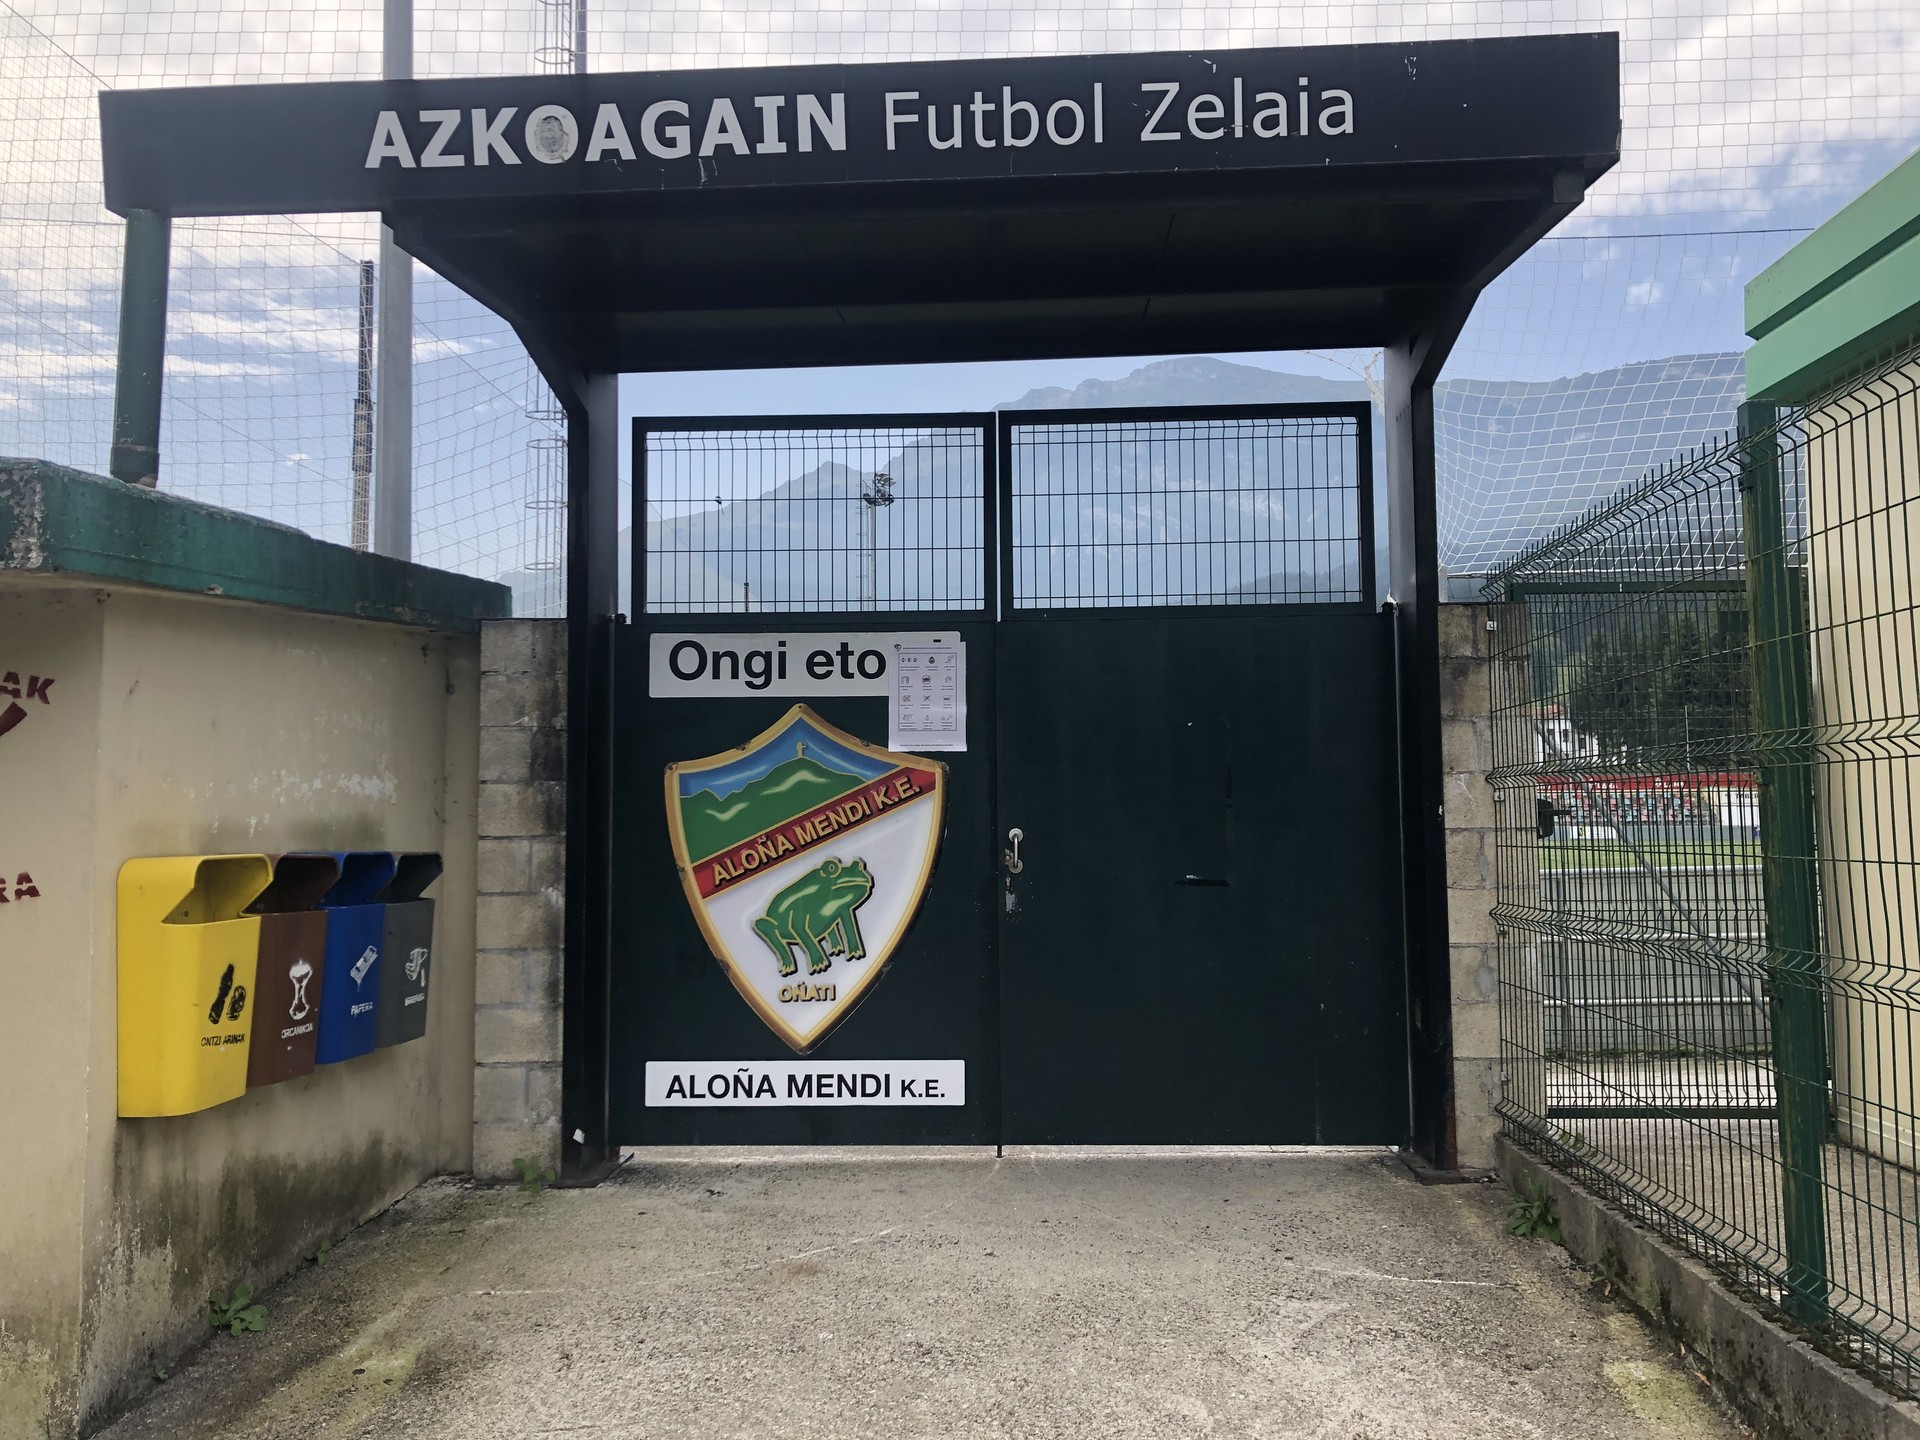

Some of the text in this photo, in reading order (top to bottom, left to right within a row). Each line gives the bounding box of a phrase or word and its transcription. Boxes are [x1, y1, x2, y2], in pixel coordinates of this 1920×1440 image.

[365, 77, 1354, 169] AZKOAGAIN Futbol Zelaia
[669, 640, 887, 690] Ongi eto
[714, 776, 922, 886] ALOÑA MENDI K.E.
[778, 982, 836, 1003] OÑATI
[201, 1036, 222, 1047] ONTZI
[665, 1068, 945, 1099] ALOÑA MENDI K.E.
